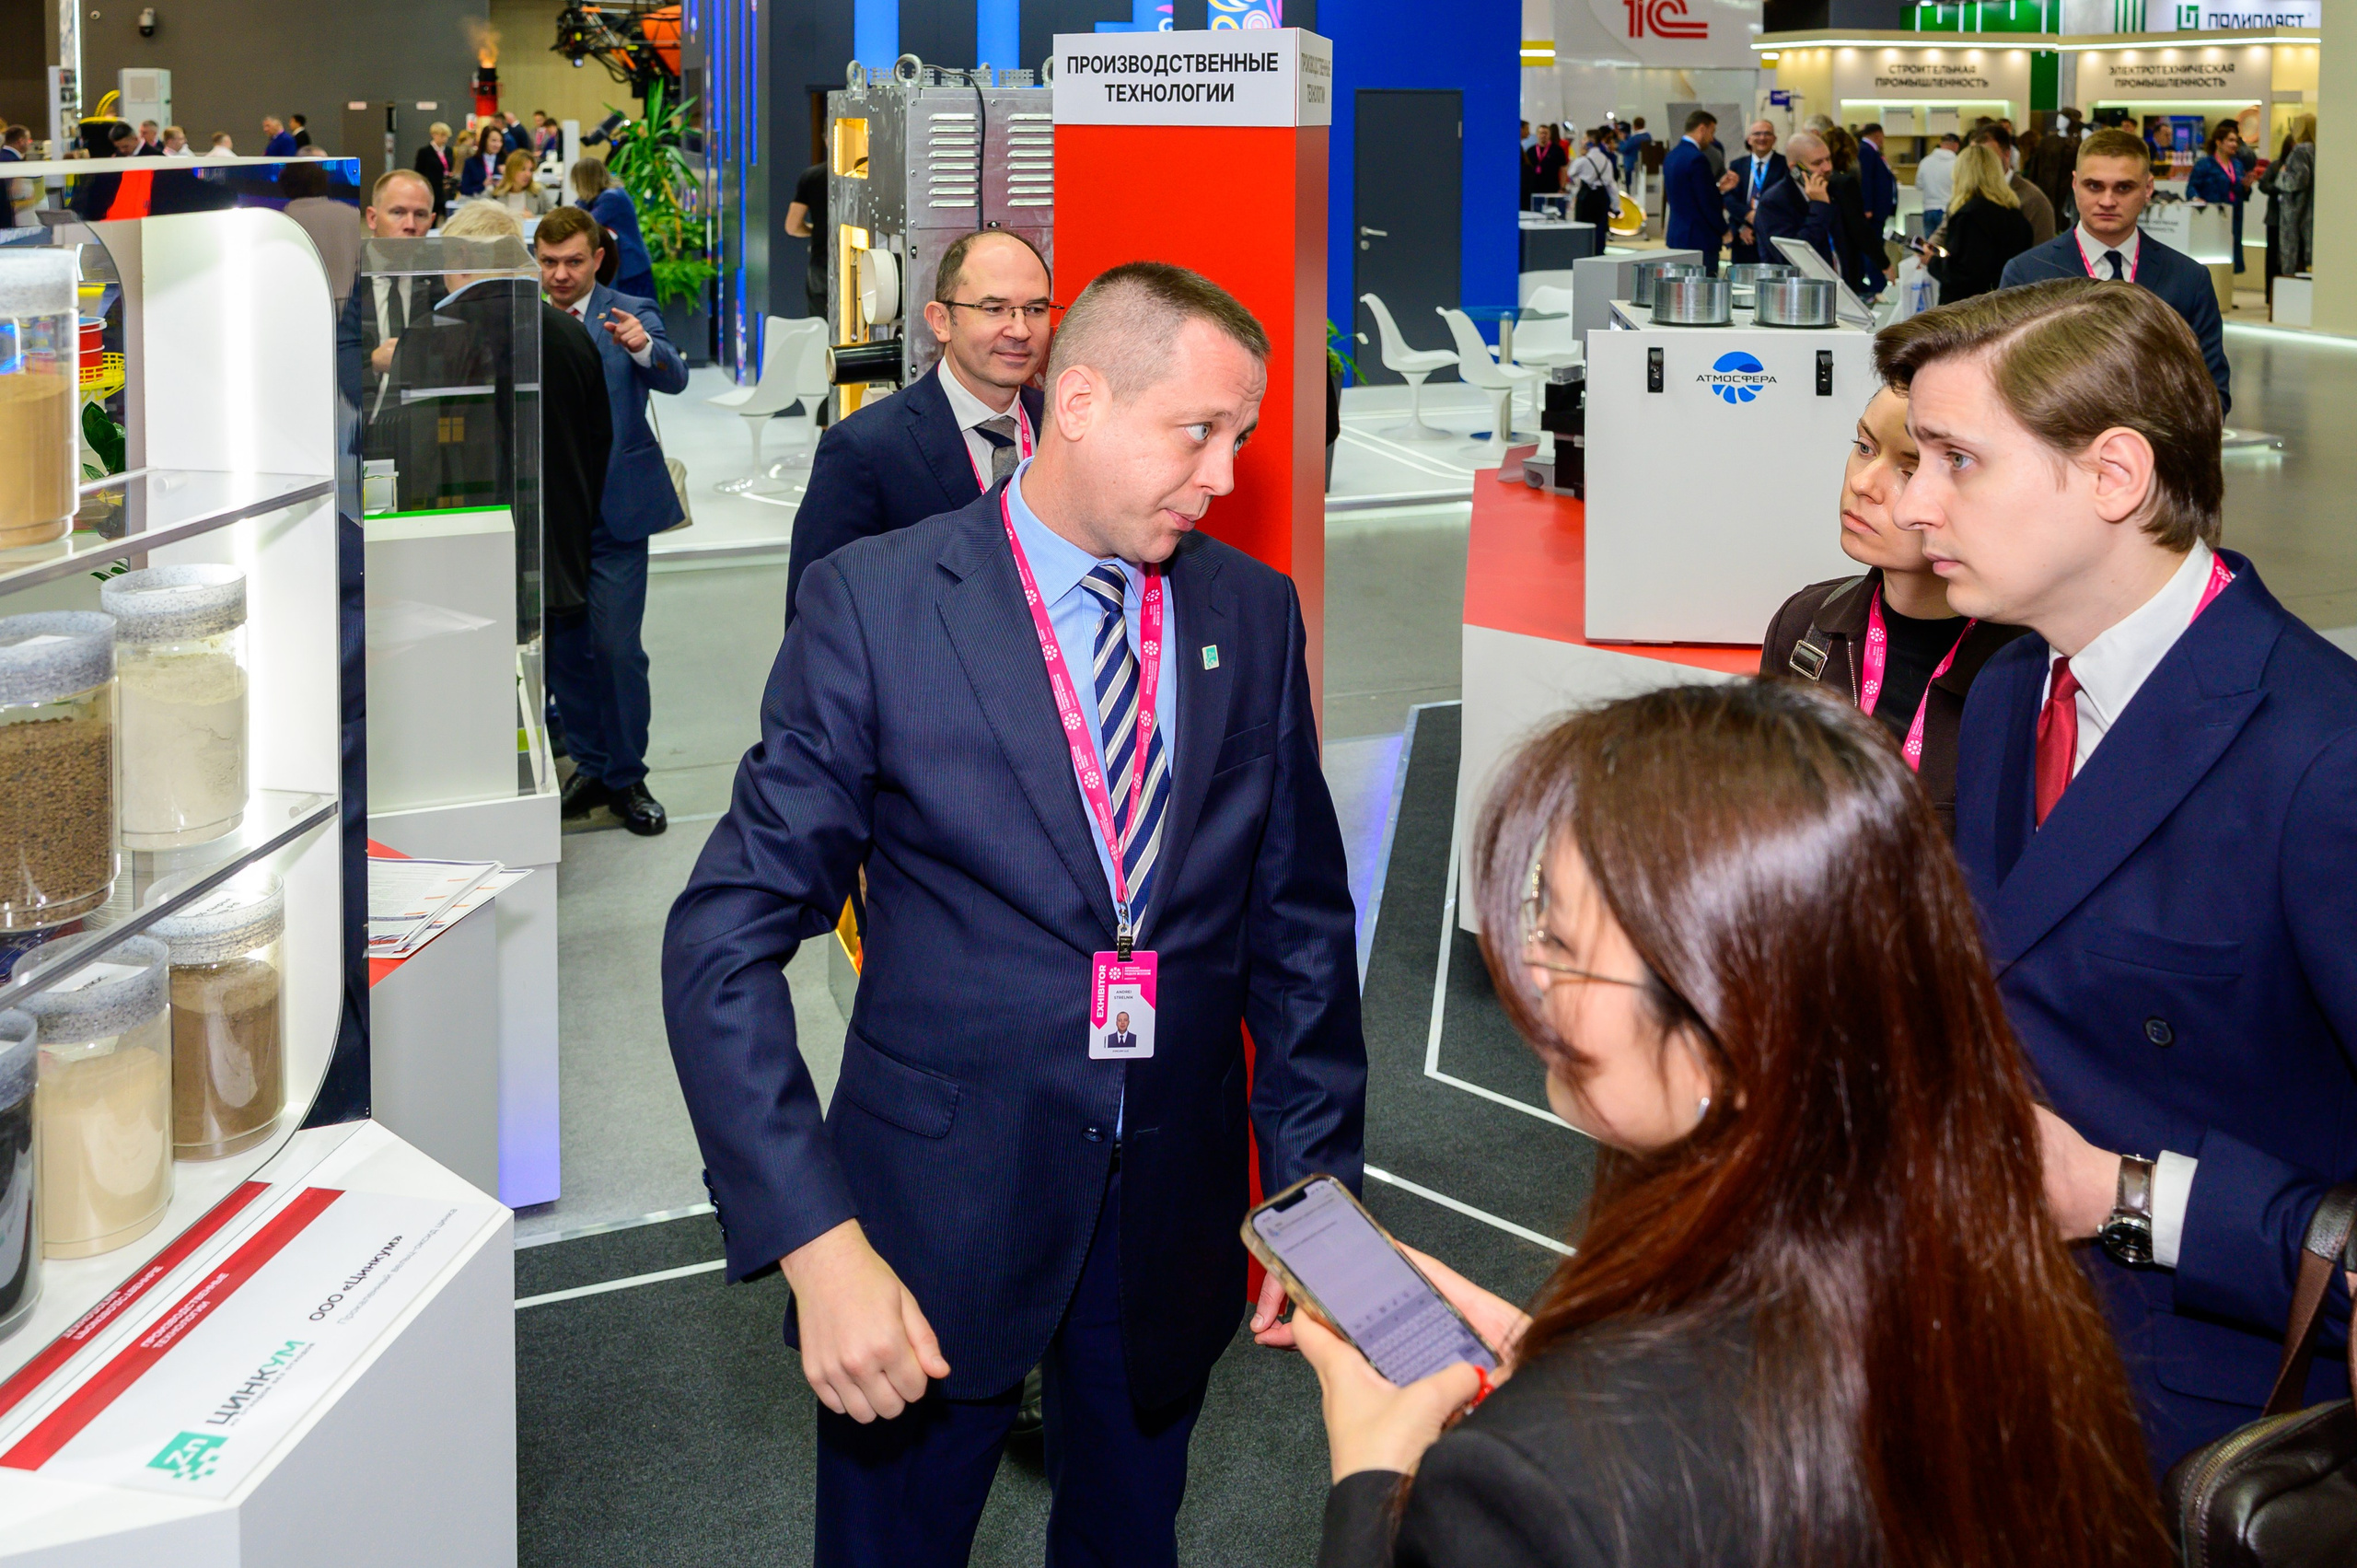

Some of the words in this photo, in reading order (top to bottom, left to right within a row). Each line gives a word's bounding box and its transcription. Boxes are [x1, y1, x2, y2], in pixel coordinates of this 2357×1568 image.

[1066, 52, 1279, 76] ПРОИЗВОДСТВЕННЫЕ
[1888, 64, 1977, 75] СТРОИТЕЛЬНАЯ
[2108, 63, 2235, 75] ЭЛЕКТРОТЕХНИЧЕСКАЯ
[1104, 83, 1235, 102] ТЕХНОЛОГИИ
[1875, 77, 1990, 87] ПРОМЫШЛЕННОСТЬ
[2114, 76, 2226, 87] ПРОМЫШЛЕННОСТЬ
[1696, 374, 1778, 383] АТМОСФЕРА
[1097, 965, 1107, 1017] EXHIBITOR
[435, 1208, 458, 1228] цинка
[309, 1294, 343, 1320] ООО
[343, 1235, 402, 1291] «Цинкум»
[140, 1272, 229, 1348] ПРОИЗВОДСТВЕННЫЕ
[152, 1301, 211, 1349] ТЕХНОЛОГИИ
[205, 1340, 306, 1425] ЦИНКУМ
[163, 1437, 209, 1467] Zn
